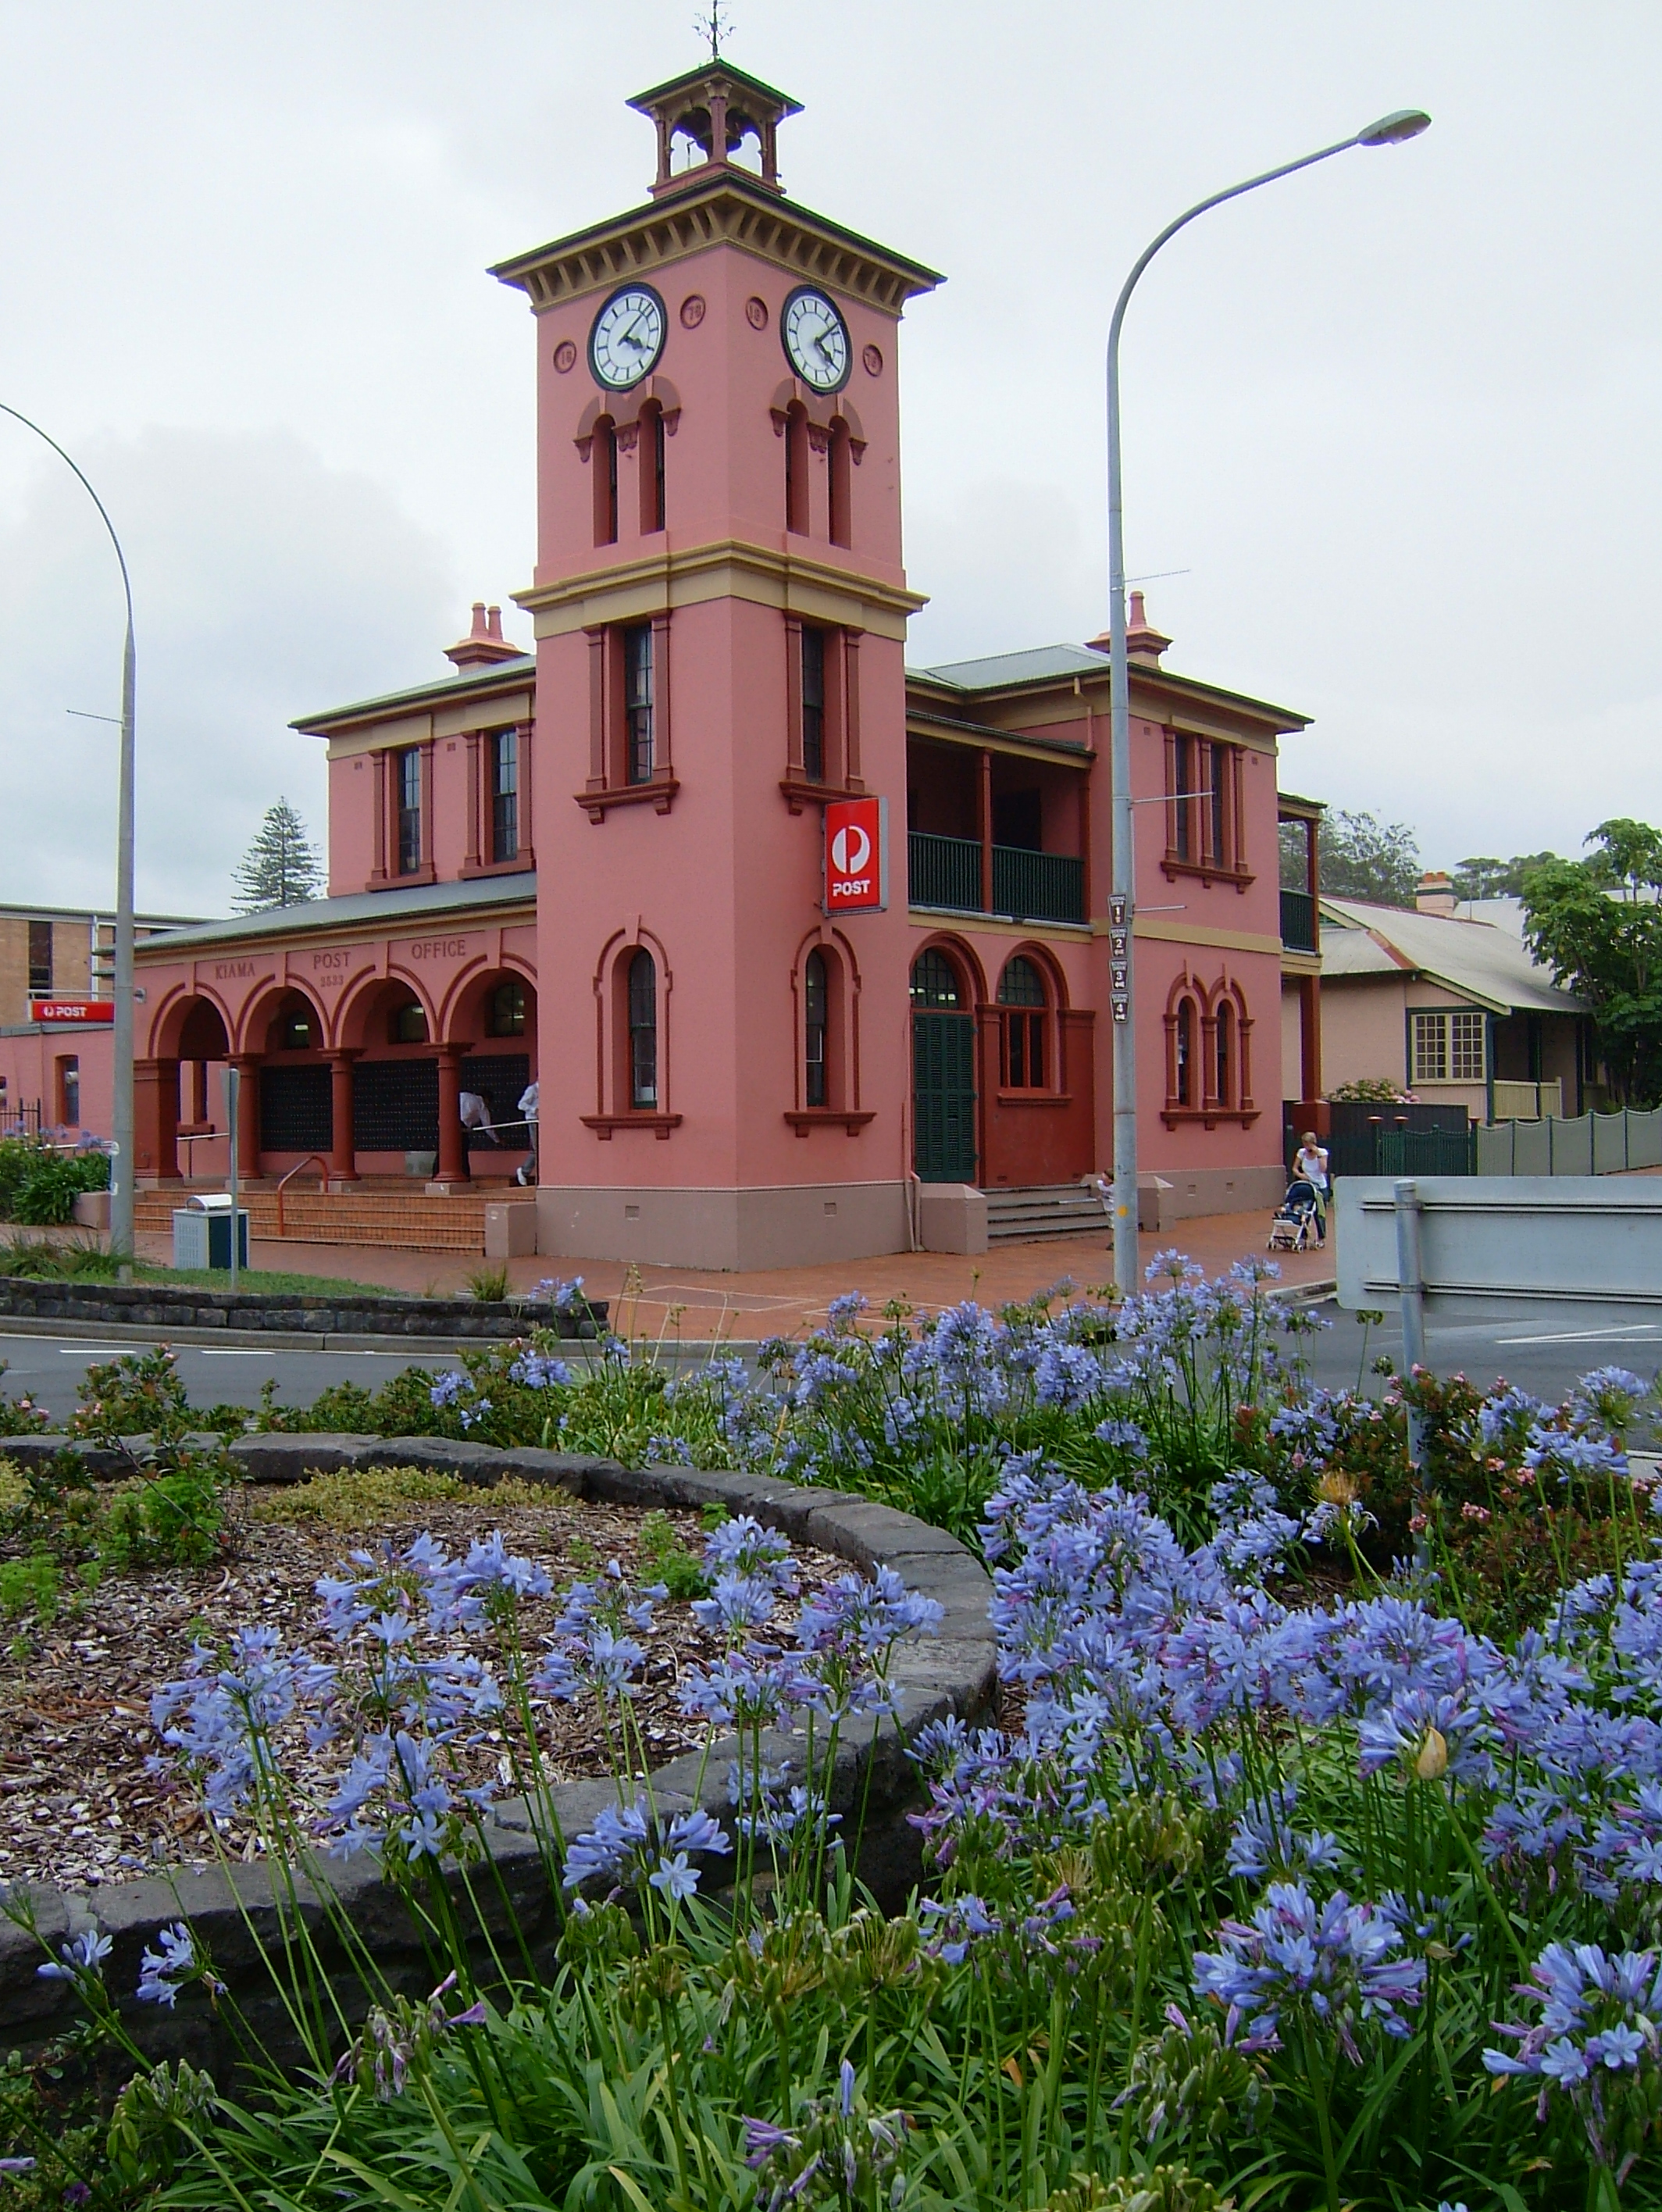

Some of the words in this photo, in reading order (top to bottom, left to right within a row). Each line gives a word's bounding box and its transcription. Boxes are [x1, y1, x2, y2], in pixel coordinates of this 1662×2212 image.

[832, 879, 871, 897] POST
[1114, 905, 1121, 915] 1
[1116, 938, 1123, 948] 2
[215, 962, 256, 979] KIAMA
[314, 951, 351, 969] POST
[411, 939, 466, 960] OFFICE
[1116, 971, 1123, 980] 3
[56, 1006, 87, 1017] POST
[1116, 1003, 1123, 1013] 4
